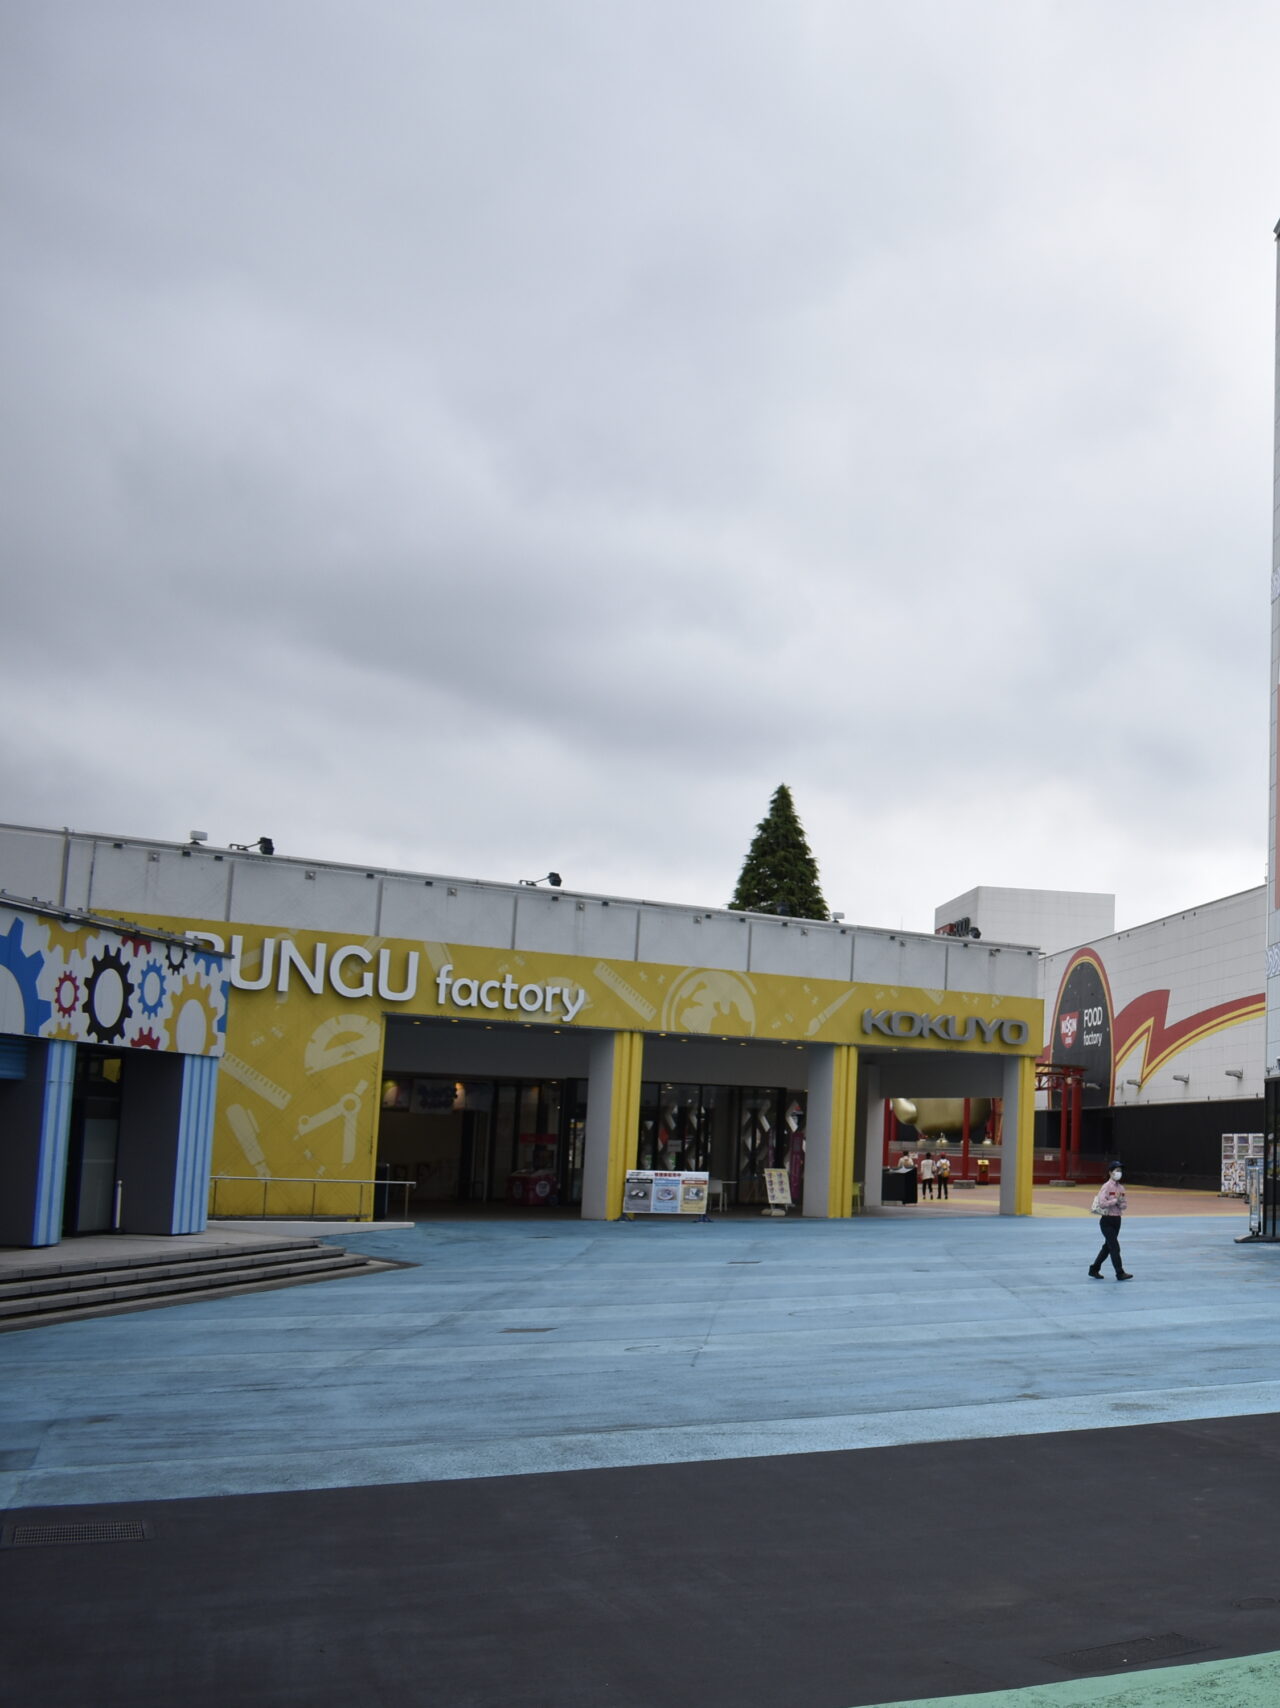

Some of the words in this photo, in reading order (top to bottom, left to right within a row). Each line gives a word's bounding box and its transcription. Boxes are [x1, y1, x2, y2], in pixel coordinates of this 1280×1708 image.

[436, 964, 585, 1022] factory
[863, 1008, 1028, 1045] KOKUYO
[1084, 1006, 1103, 1028] FOOD
[1083, 1030, 1103, 1047] factory
